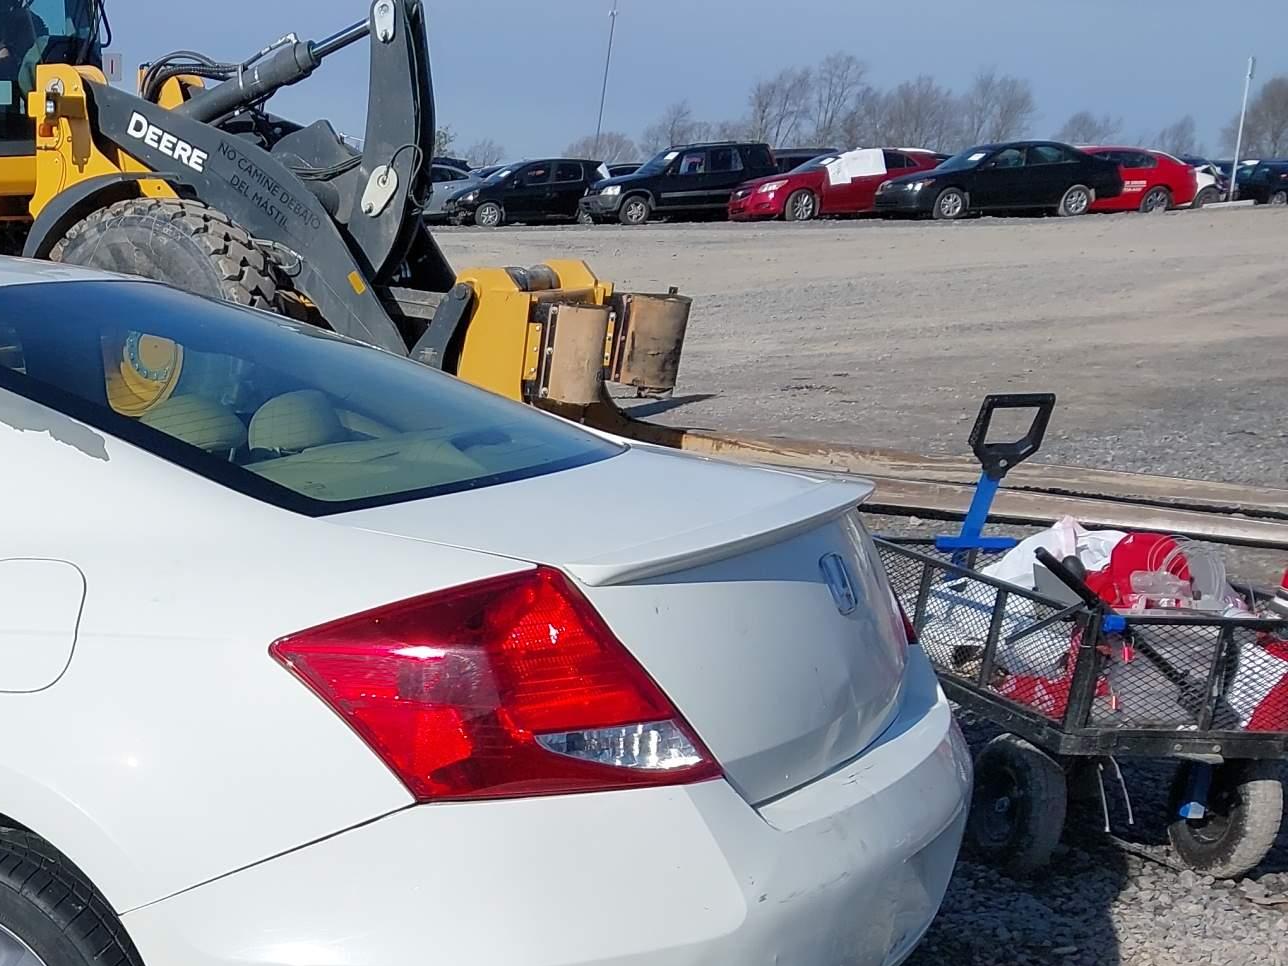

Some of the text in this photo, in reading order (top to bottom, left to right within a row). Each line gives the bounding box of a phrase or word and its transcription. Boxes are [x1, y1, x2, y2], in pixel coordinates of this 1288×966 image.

[127, 112, 208, 172] DEERE
[219, 142, 321, 230] NO CAMINE DEBAJO
[230, 174, 249, 196] DEL
